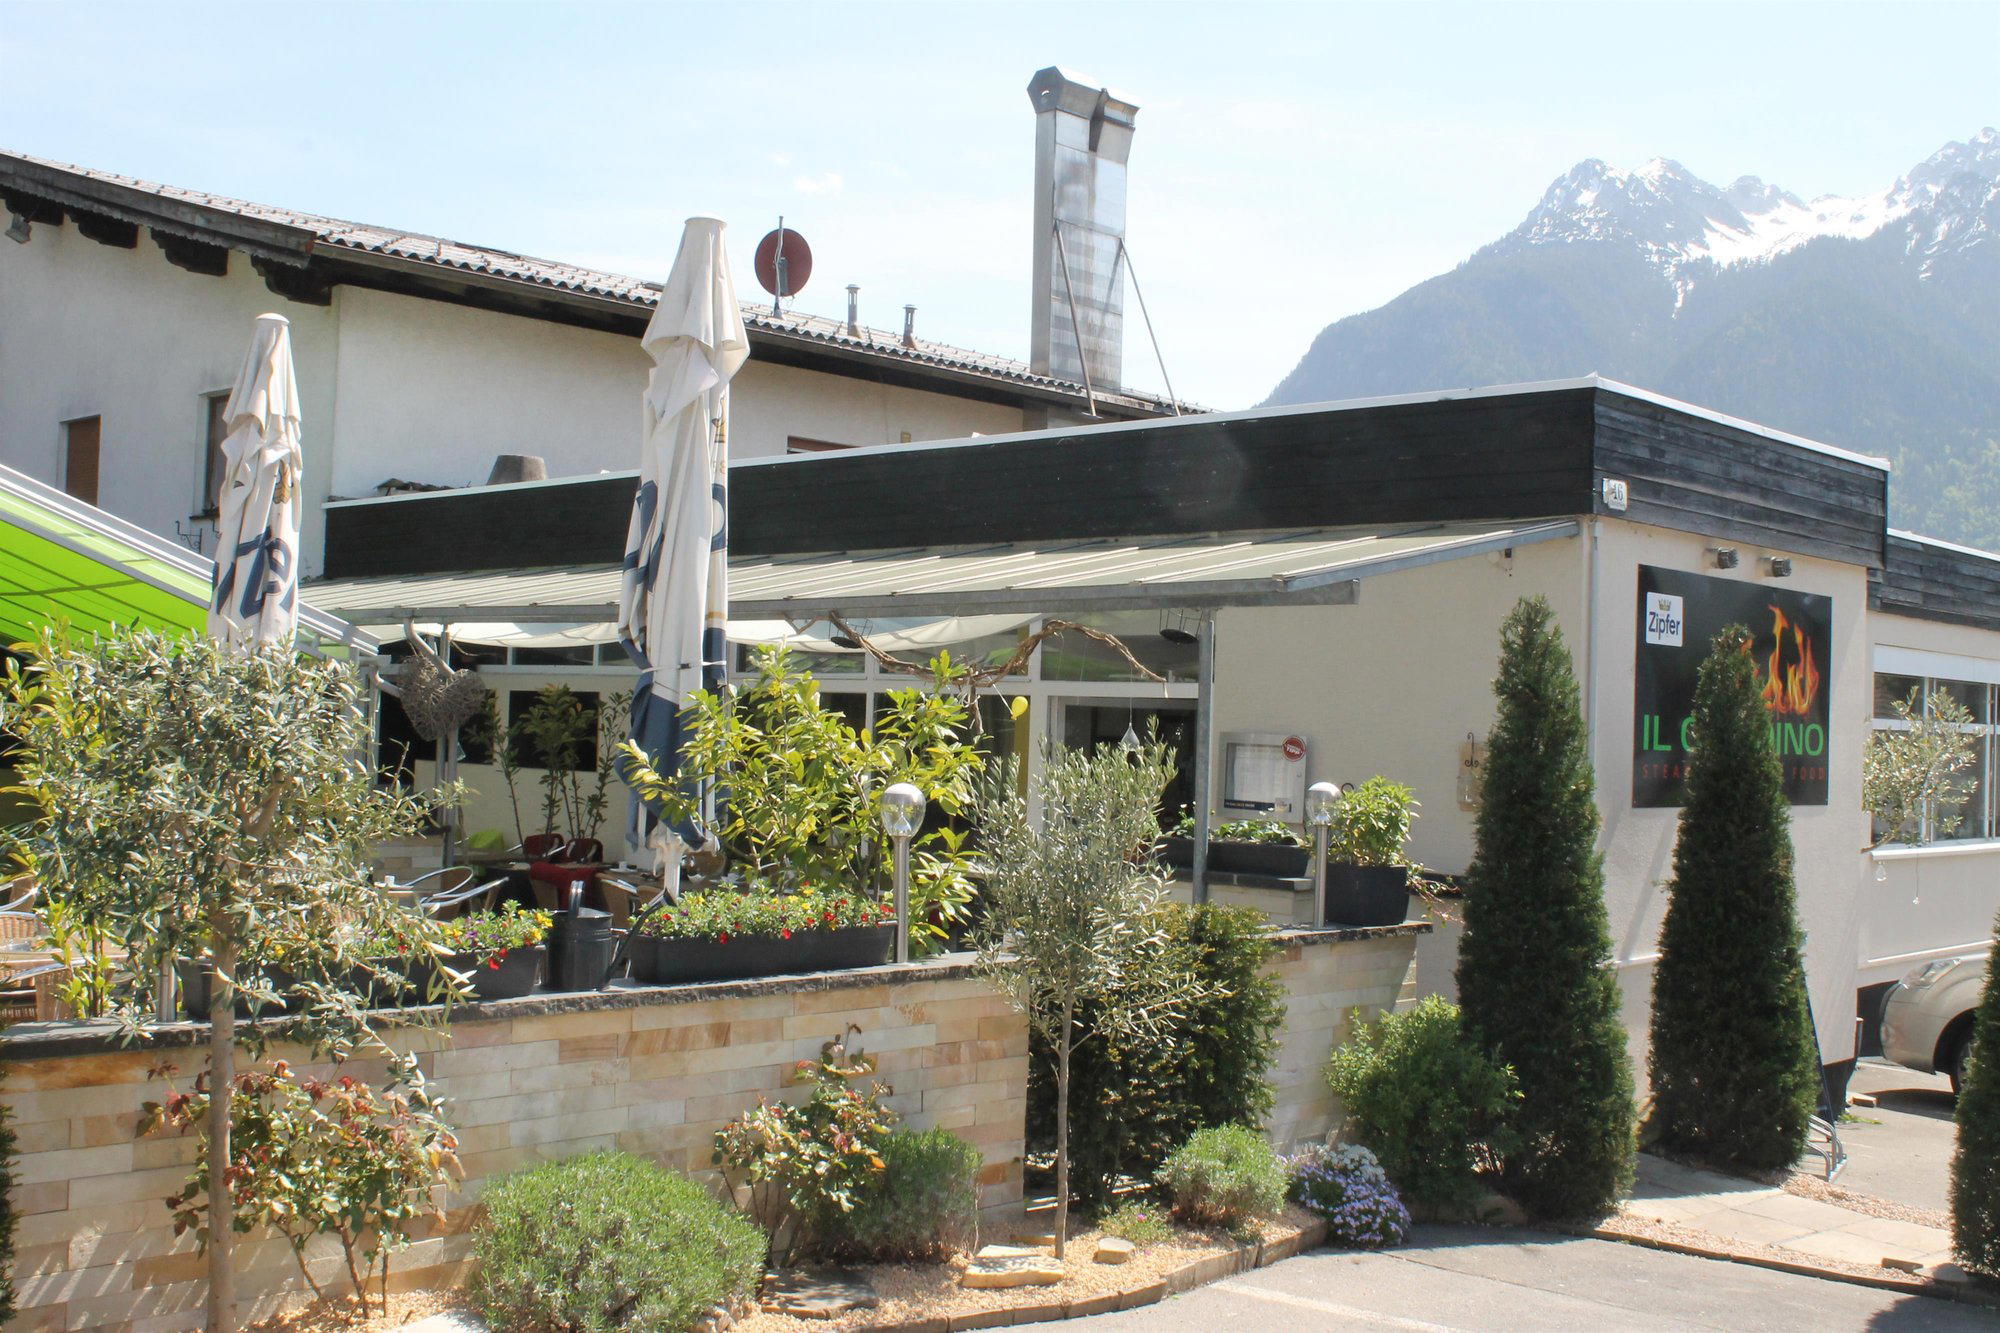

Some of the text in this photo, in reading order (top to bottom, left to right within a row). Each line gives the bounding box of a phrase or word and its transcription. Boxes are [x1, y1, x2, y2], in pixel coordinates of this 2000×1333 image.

[1648, 611, 1680, 640] Zipfer
[1643, 714, 1672, 751] IL
[1642, 764, 1691, 778] STEA
